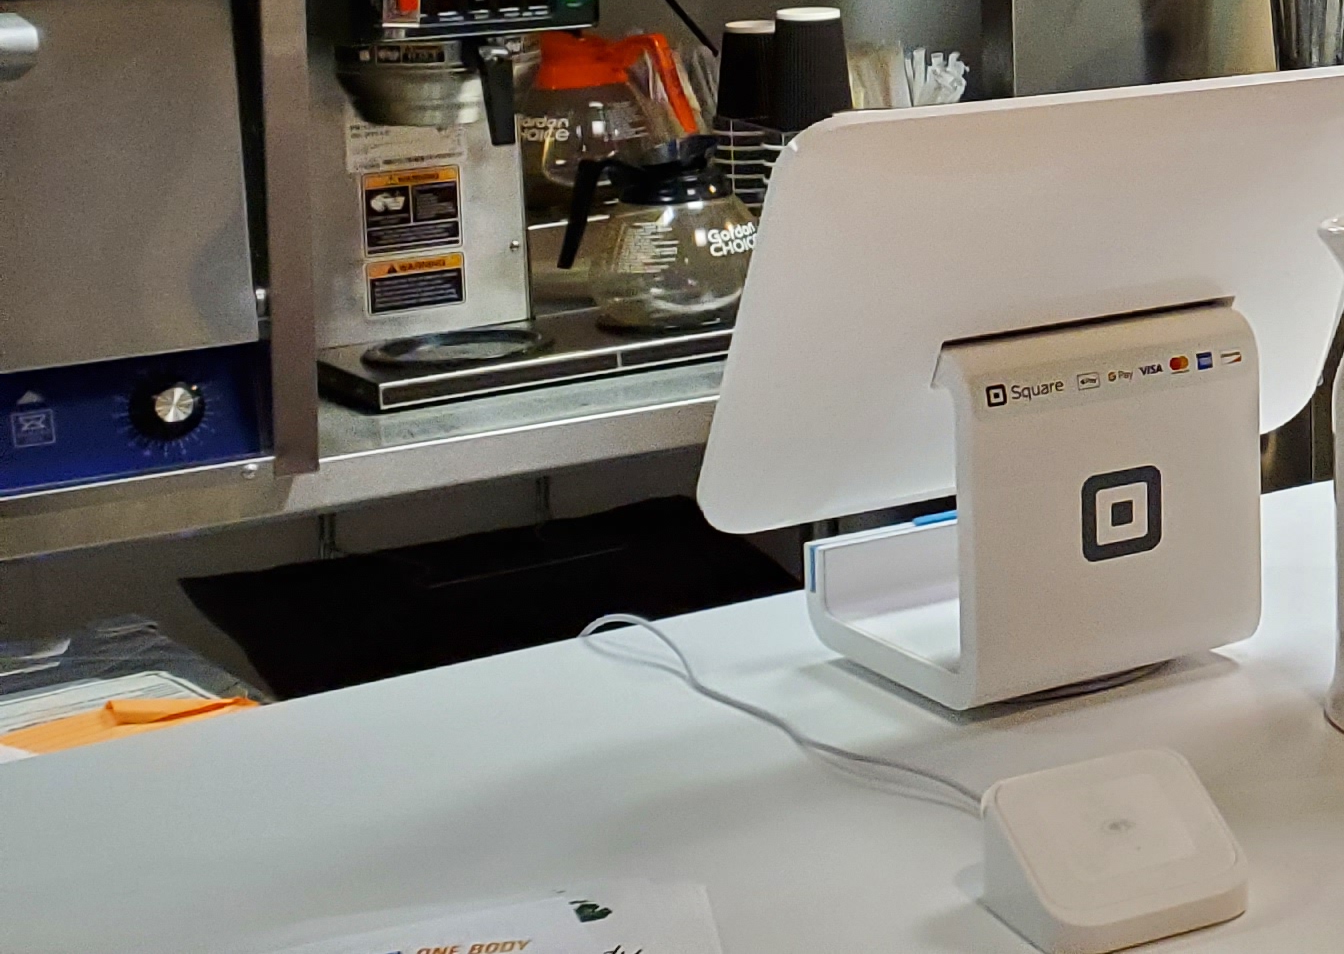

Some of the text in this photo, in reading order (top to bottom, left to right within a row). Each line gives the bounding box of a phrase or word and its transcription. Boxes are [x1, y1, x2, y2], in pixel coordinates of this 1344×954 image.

[1139, 363, 1164, 376] VISA
[1010, 378, 1066, 402] Square
[467, 939, 533, 954] BODY
